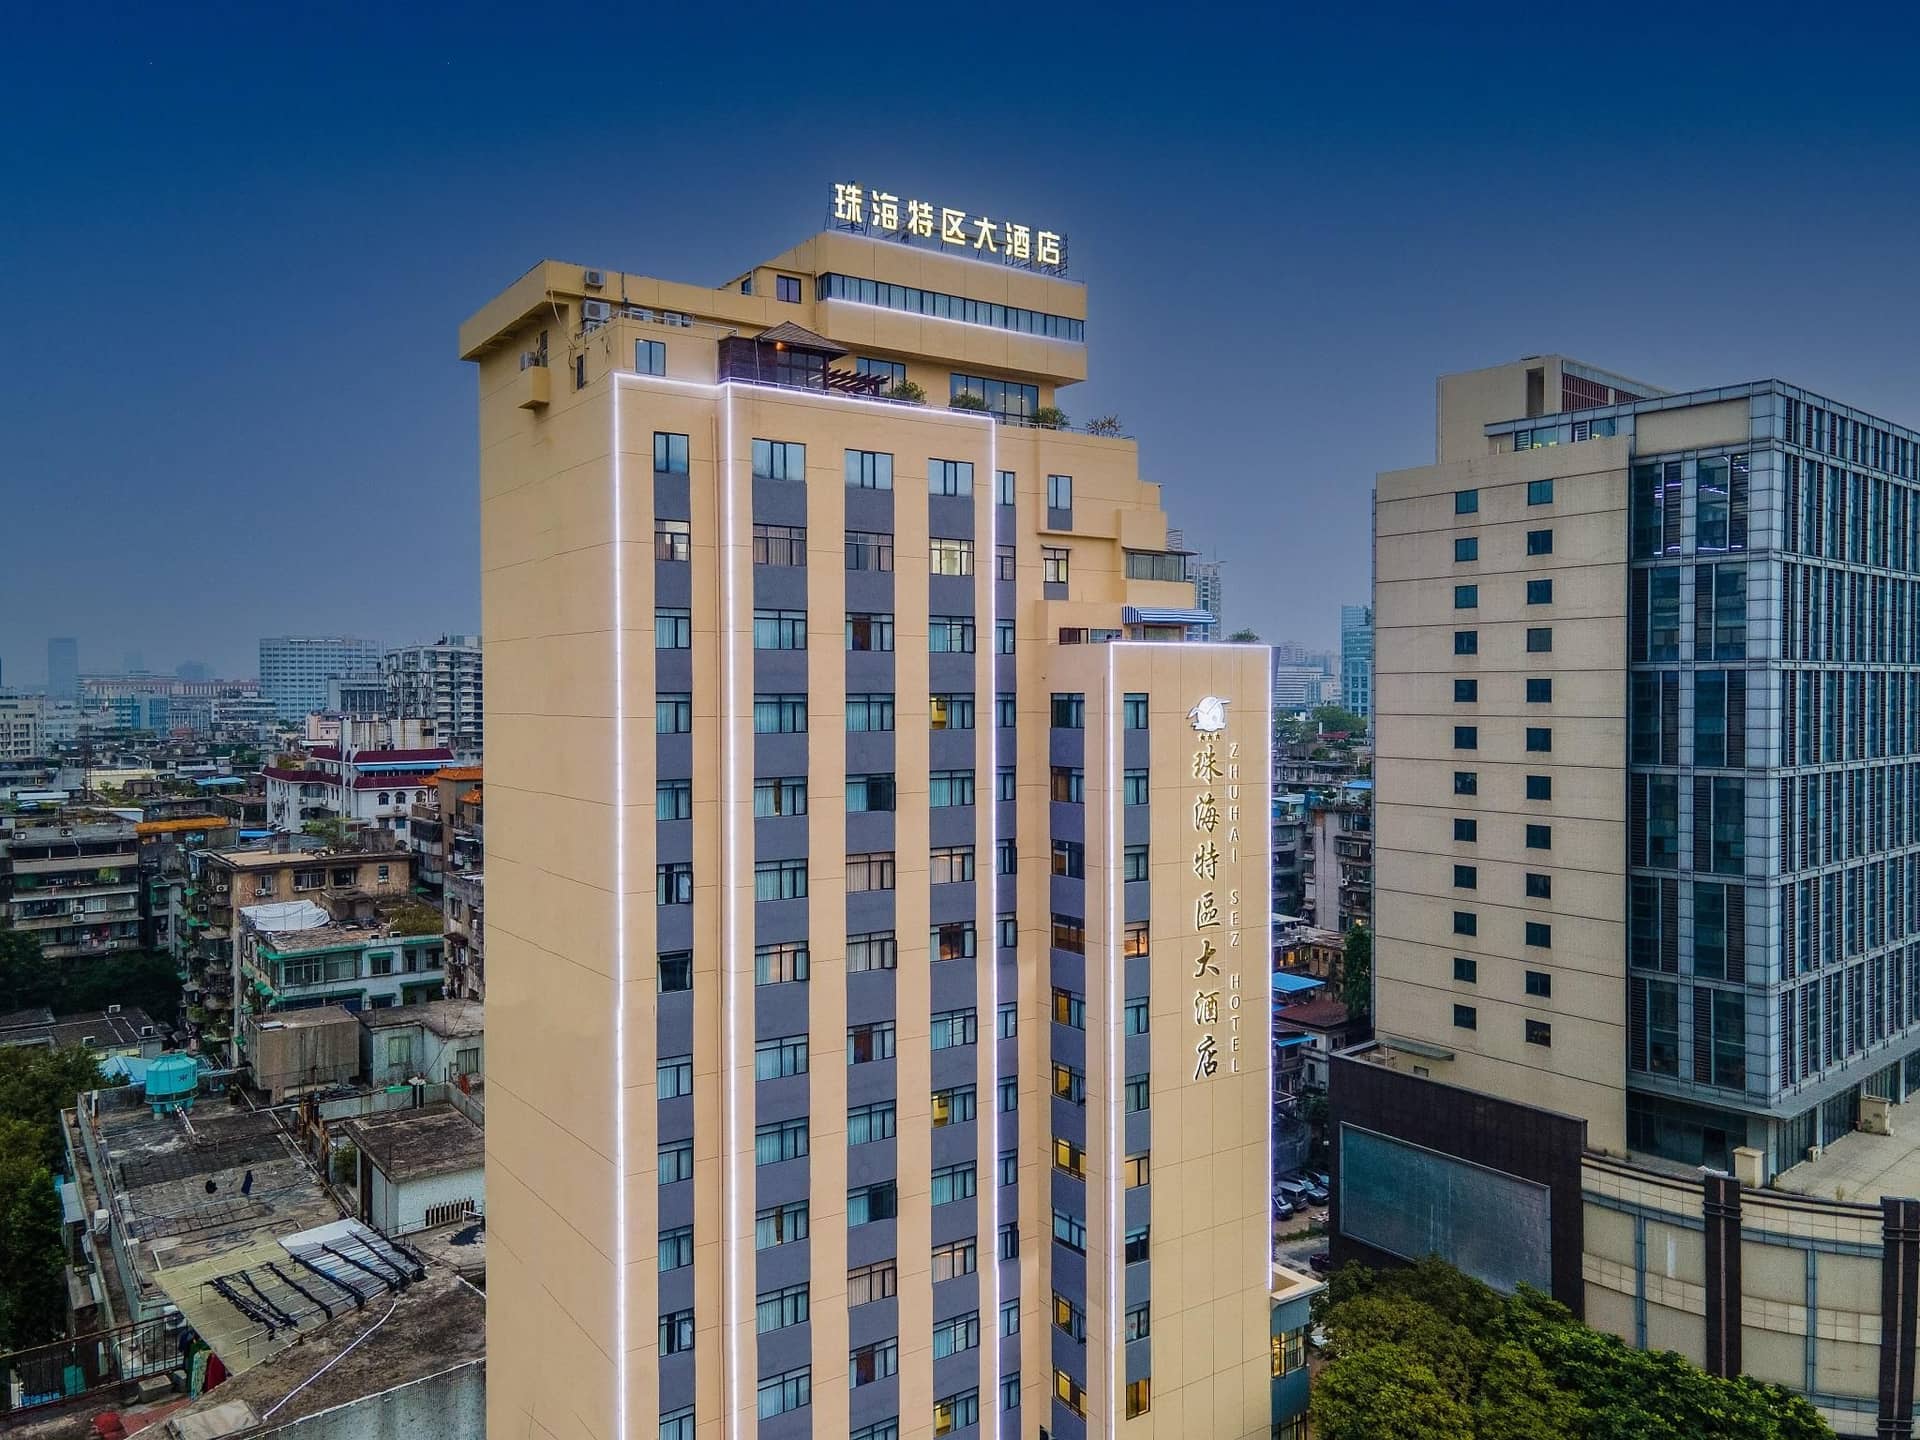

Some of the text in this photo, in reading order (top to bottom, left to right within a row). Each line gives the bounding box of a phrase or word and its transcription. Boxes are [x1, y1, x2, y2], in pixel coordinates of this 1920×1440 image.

[834, 183, 1061, 265] 珠海特区大酒店
[1192, 744, 1223, 1081] 珠海特區大酒店
[1229, 743, 1241, 1074] ZHUHAI SEZ HOTEL
